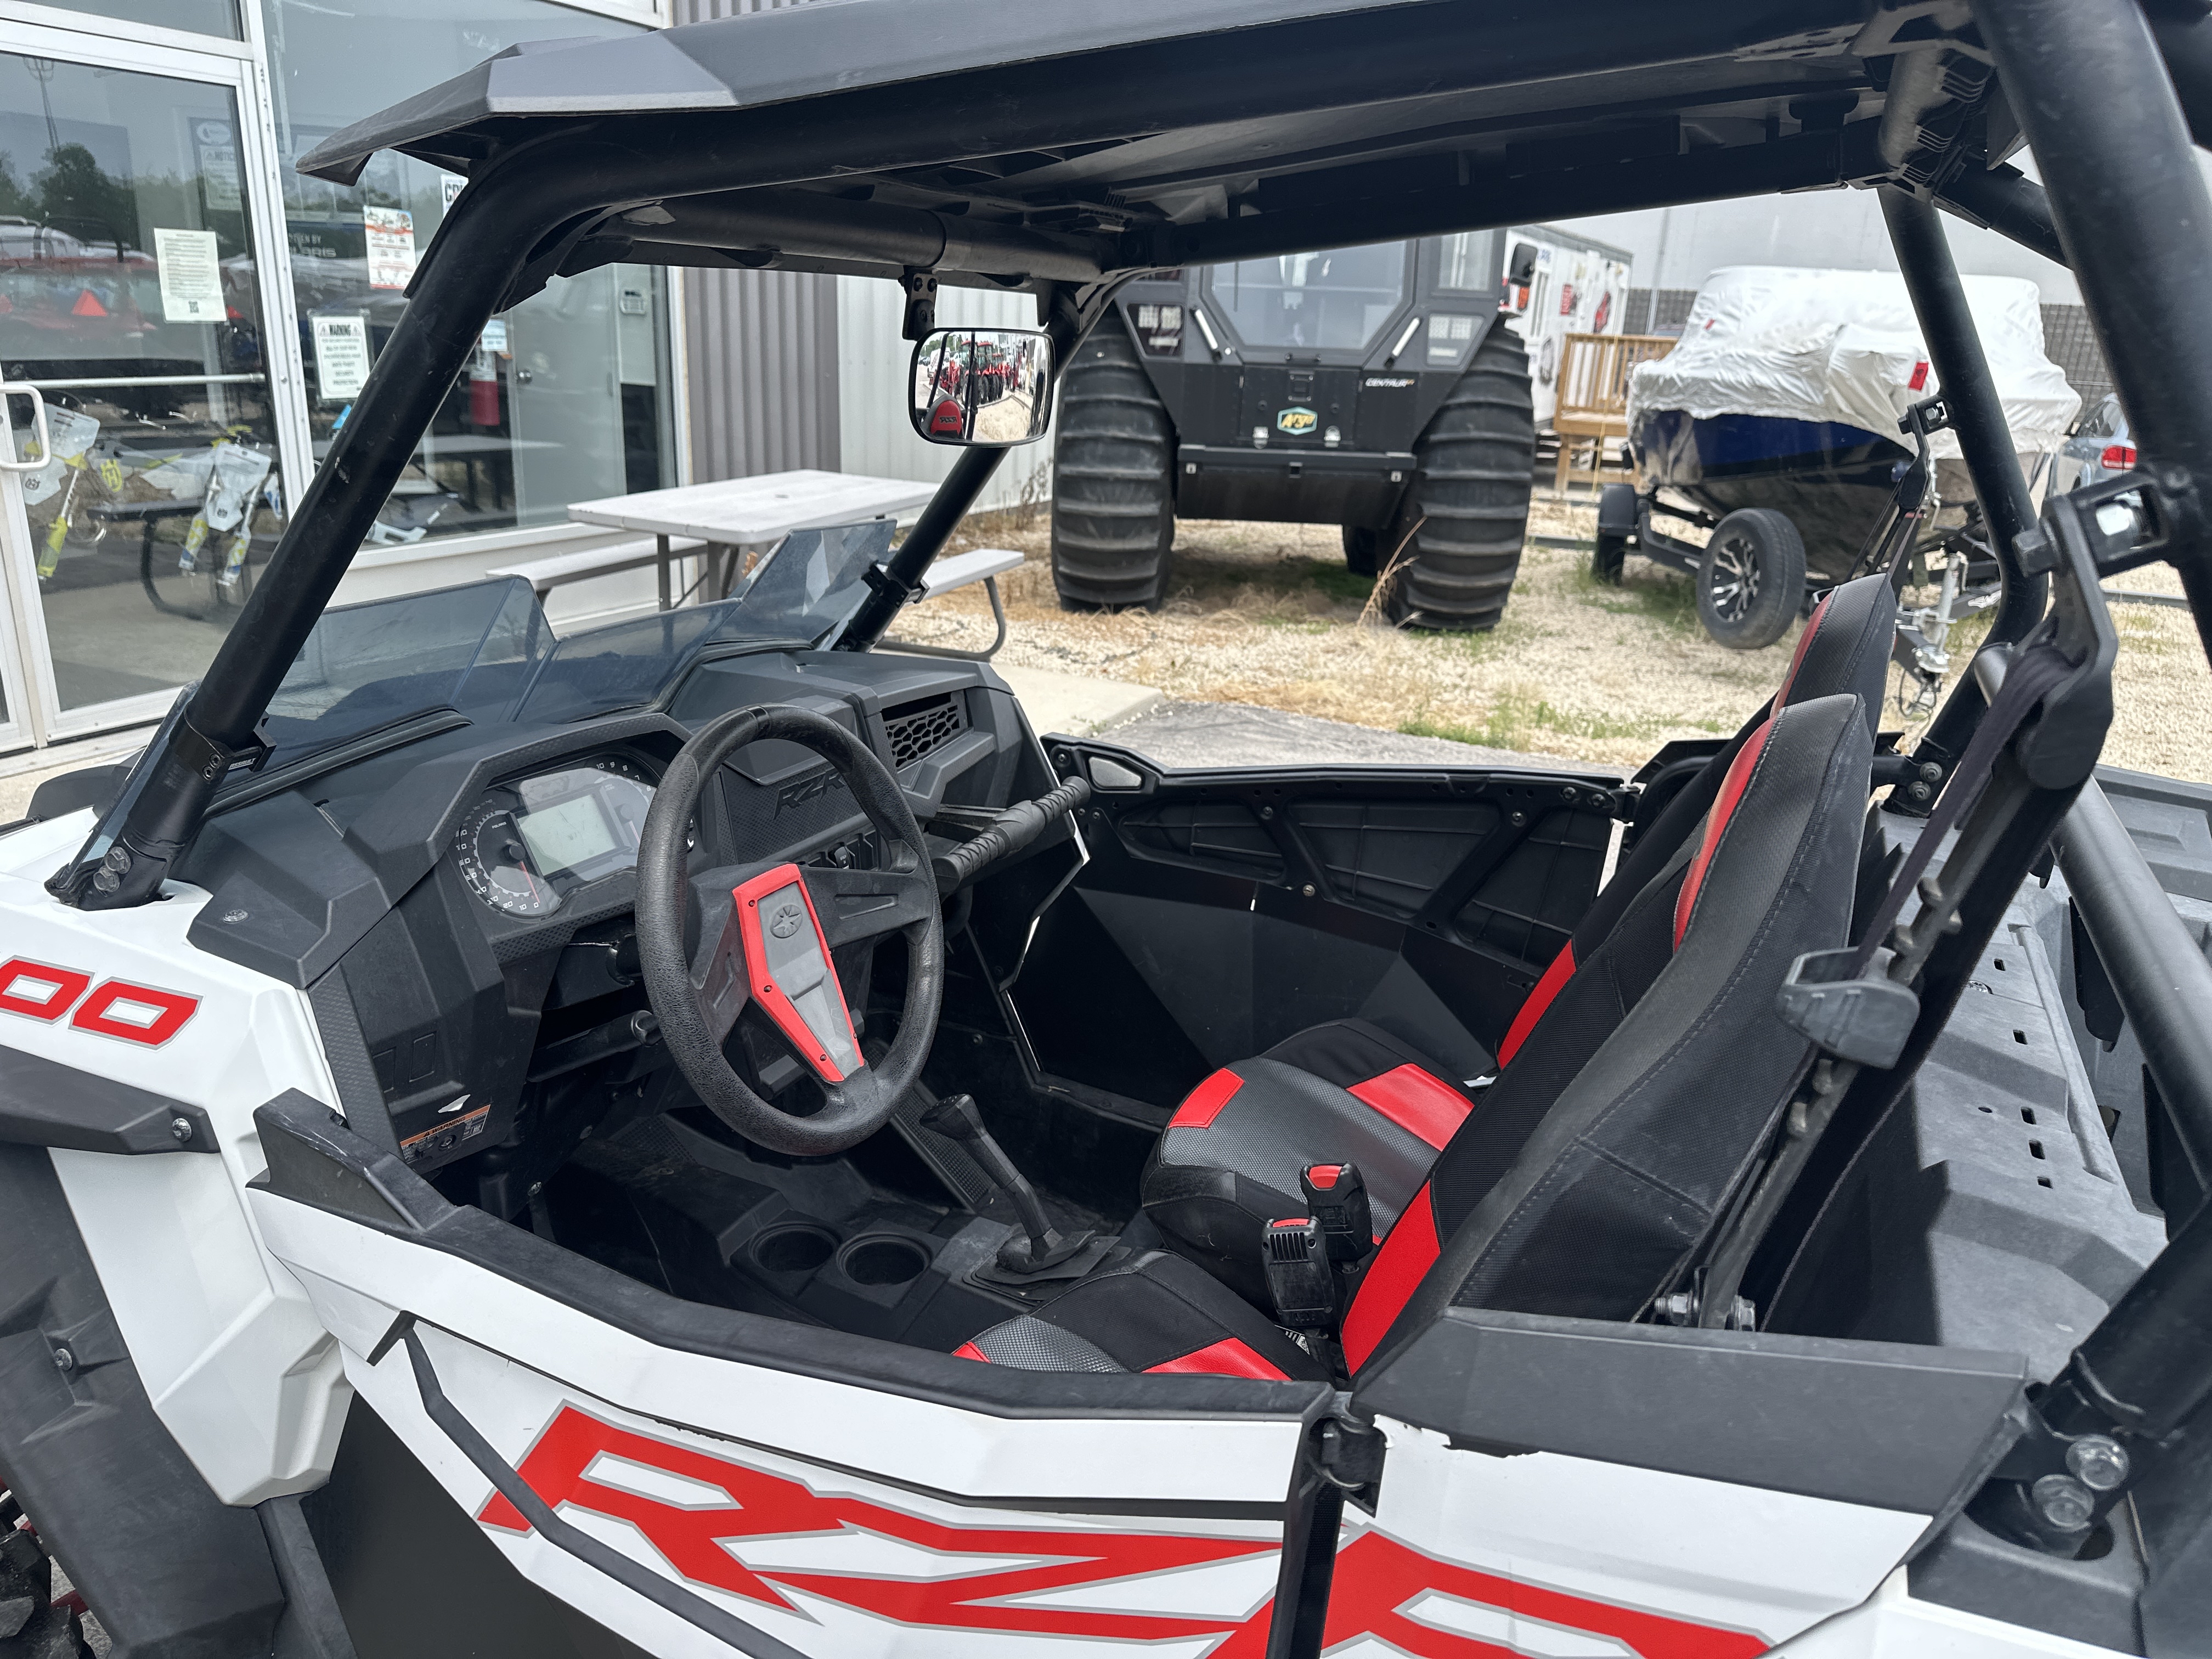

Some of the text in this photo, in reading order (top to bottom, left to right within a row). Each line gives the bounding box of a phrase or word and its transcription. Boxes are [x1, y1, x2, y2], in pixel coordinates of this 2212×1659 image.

[1365, 377, 1407, 387] CENTAUR
[772, 767, 847, 820] RZR
[466, 872, 477, 881] 50
[476, 886, 487, 895] 40
[487, 895, 499, 905] 30
[432, 1116, 466, 1134] WARNING
